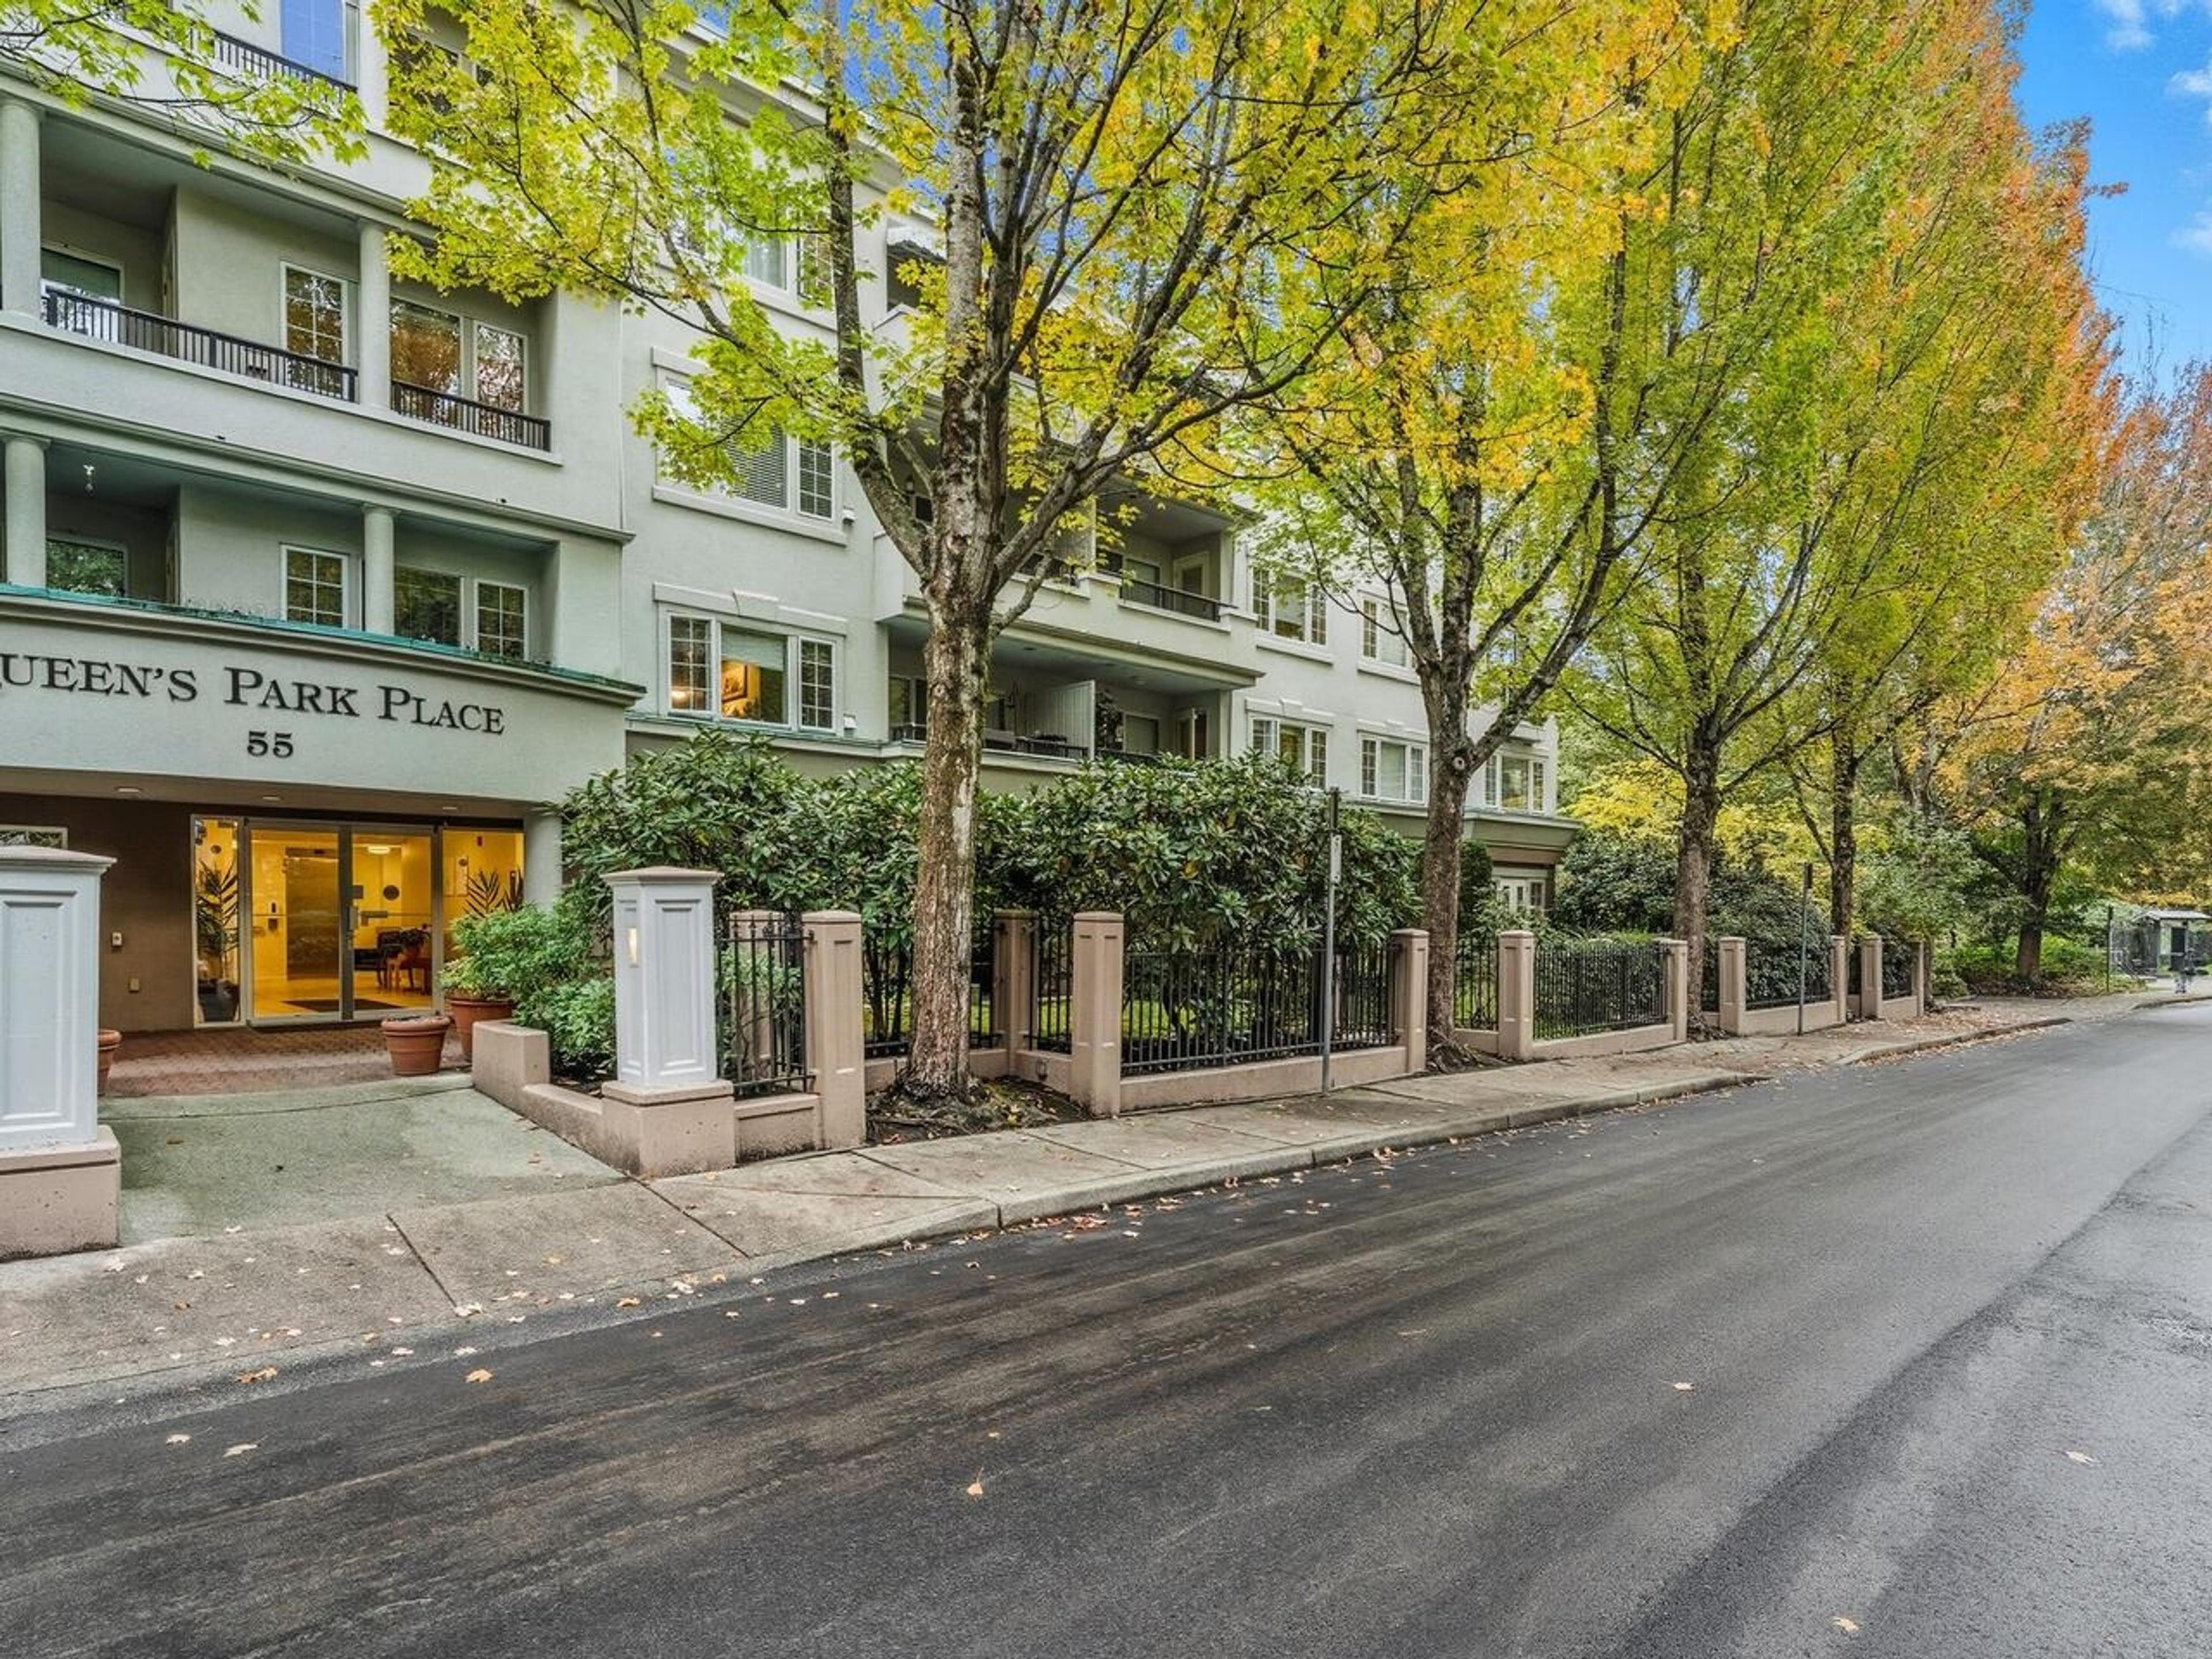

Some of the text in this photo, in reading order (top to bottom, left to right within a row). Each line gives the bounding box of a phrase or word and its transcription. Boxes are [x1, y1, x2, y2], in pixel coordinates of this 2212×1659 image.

[0, 653, 505, 736] UEEN'S PARK PLACE
[247, 730, 294, 758] 55
